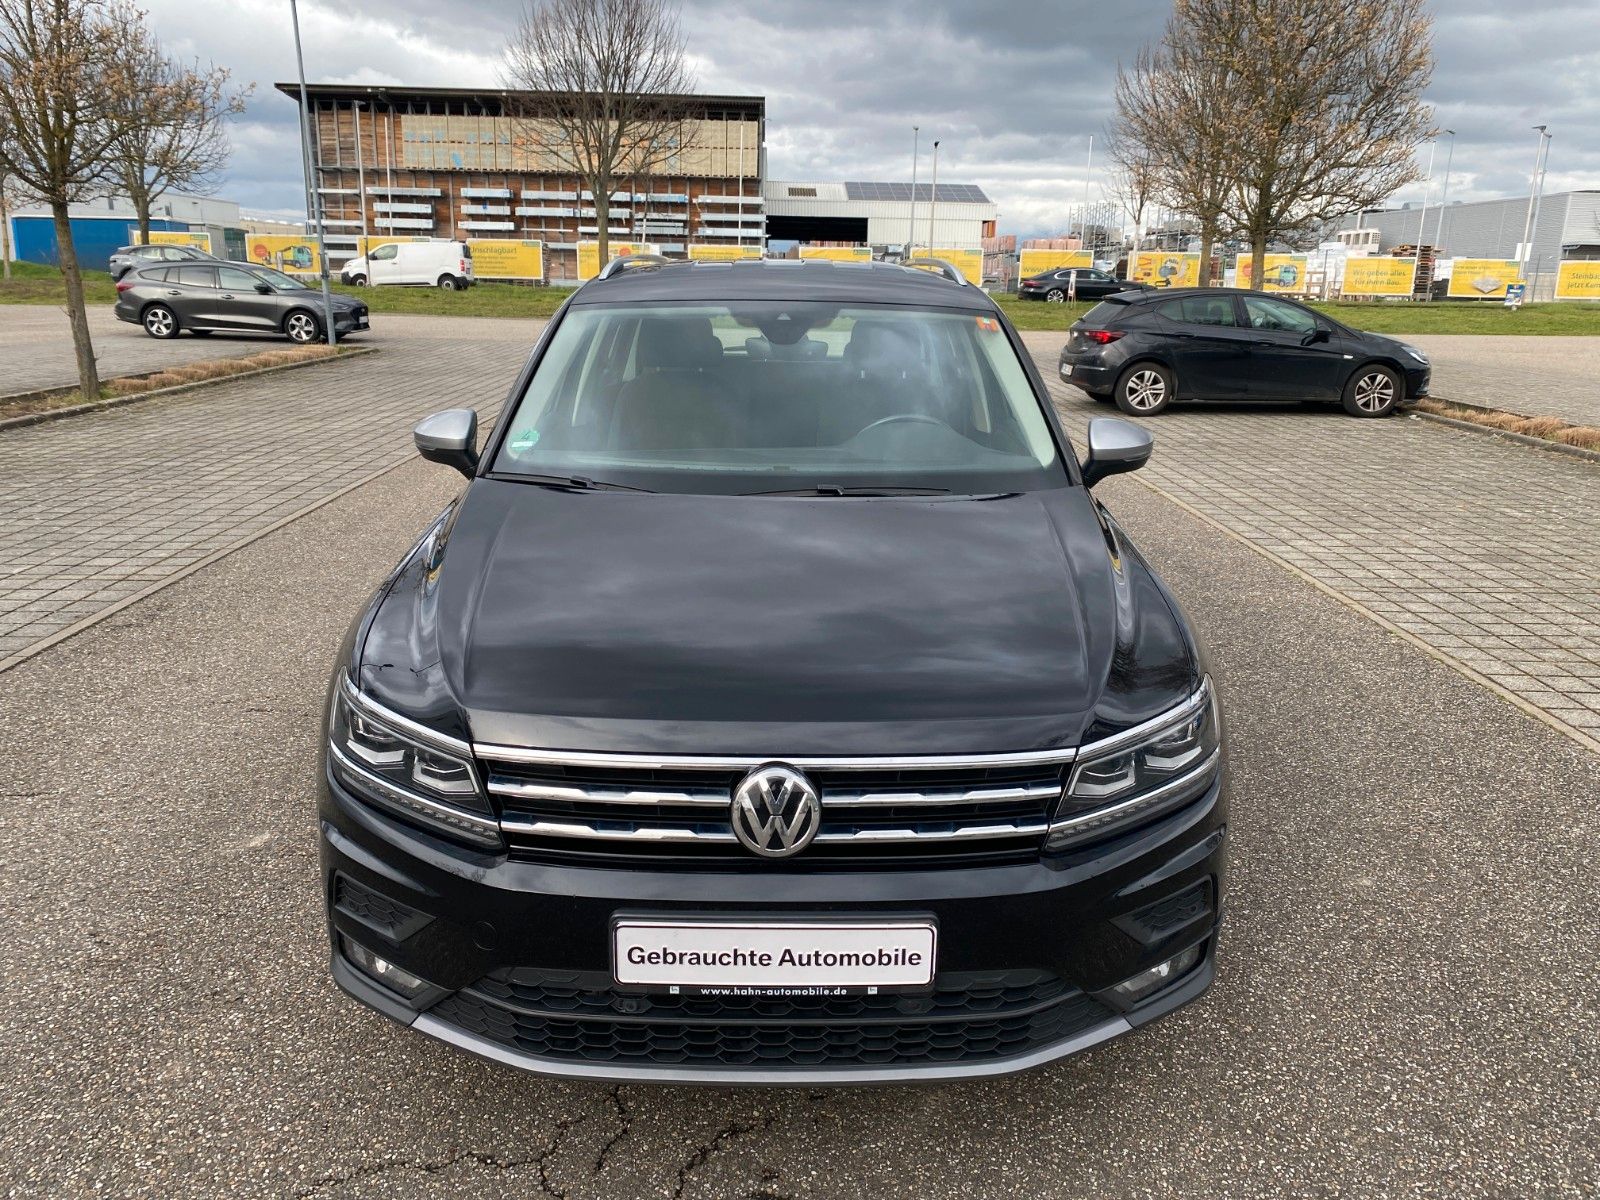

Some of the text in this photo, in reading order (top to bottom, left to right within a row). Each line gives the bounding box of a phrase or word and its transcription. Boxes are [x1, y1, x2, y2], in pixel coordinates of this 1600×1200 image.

[737, 772, 815, 853] VW
[627, 946, 922, 967] Gebrauchte Automobile
[700, 987, 848, 996] www.hahn-automobile.de
